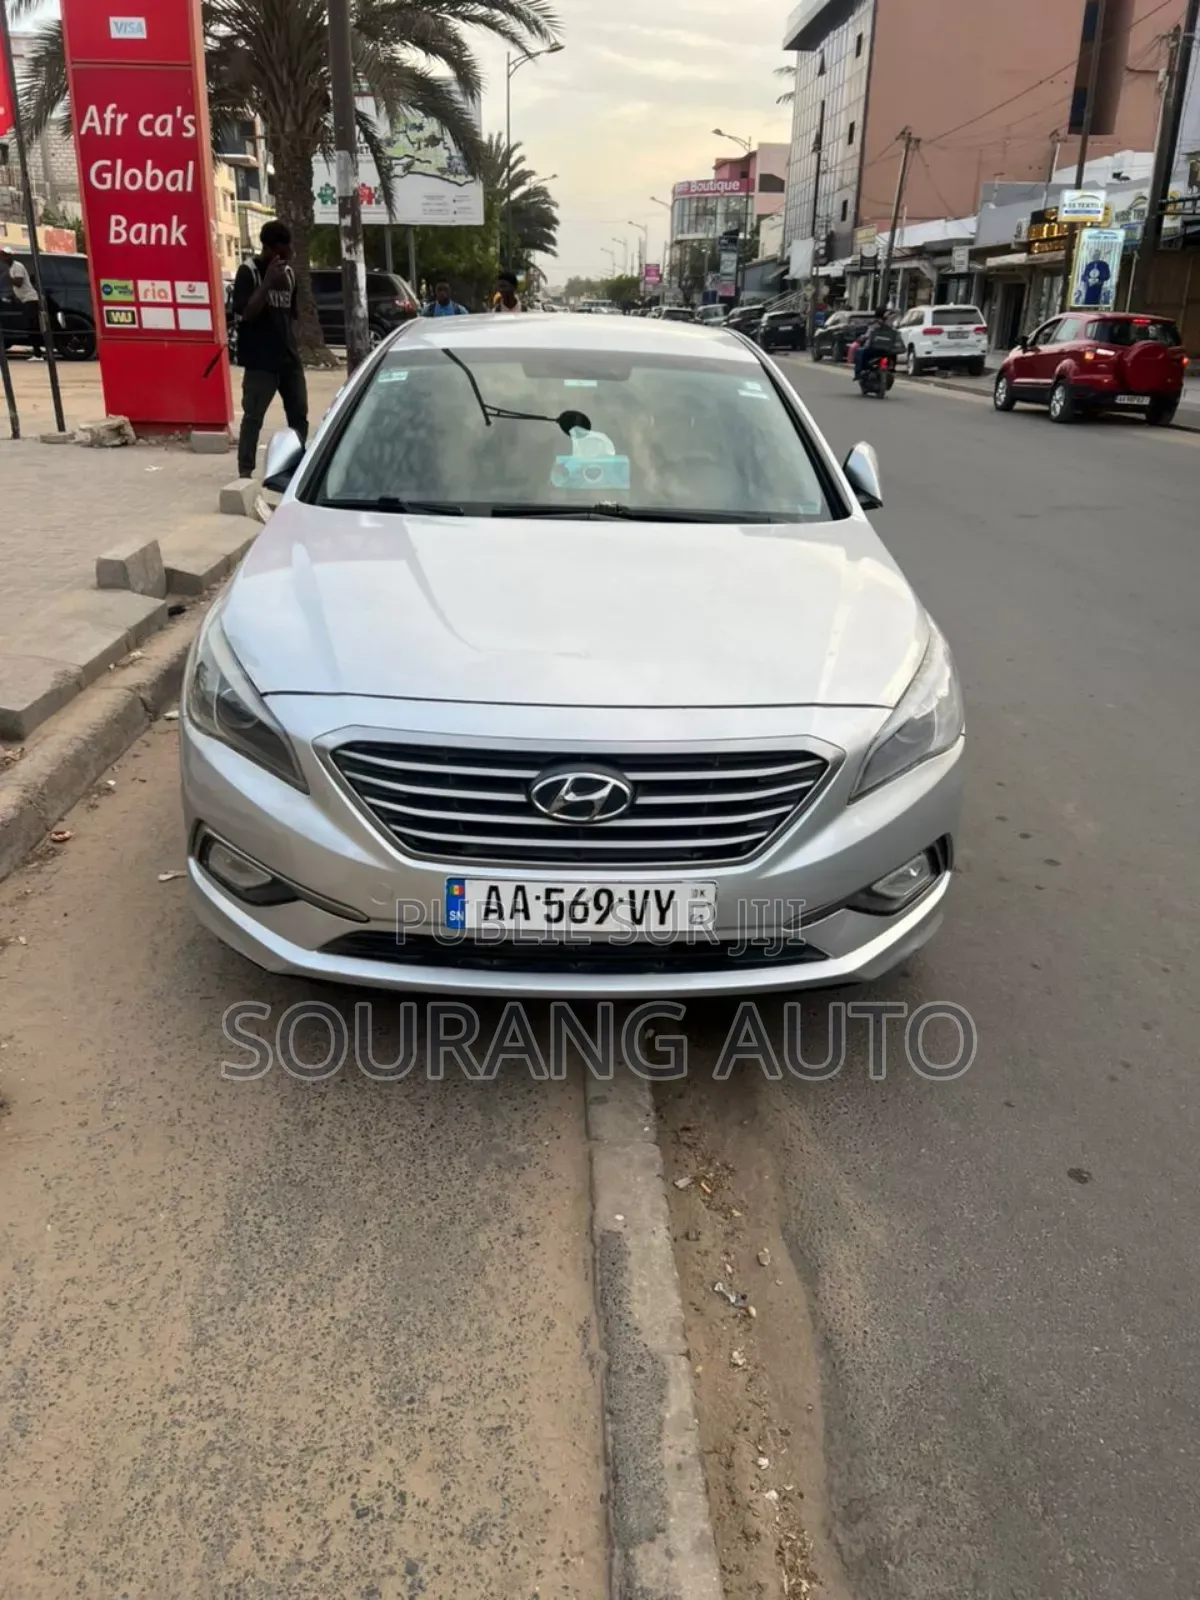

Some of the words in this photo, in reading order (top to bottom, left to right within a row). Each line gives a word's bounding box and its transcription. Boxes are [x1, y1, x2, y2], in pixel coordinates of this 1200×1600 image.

[113, 21, 145, 35] VISA
[89, 159, 194, 192] Global
[690, 180, 740, 195] Boutique
[108, 214, 188, 246] Bank
[143, 282, 169, 300] ria
[449, 910, 465, 921] SN
